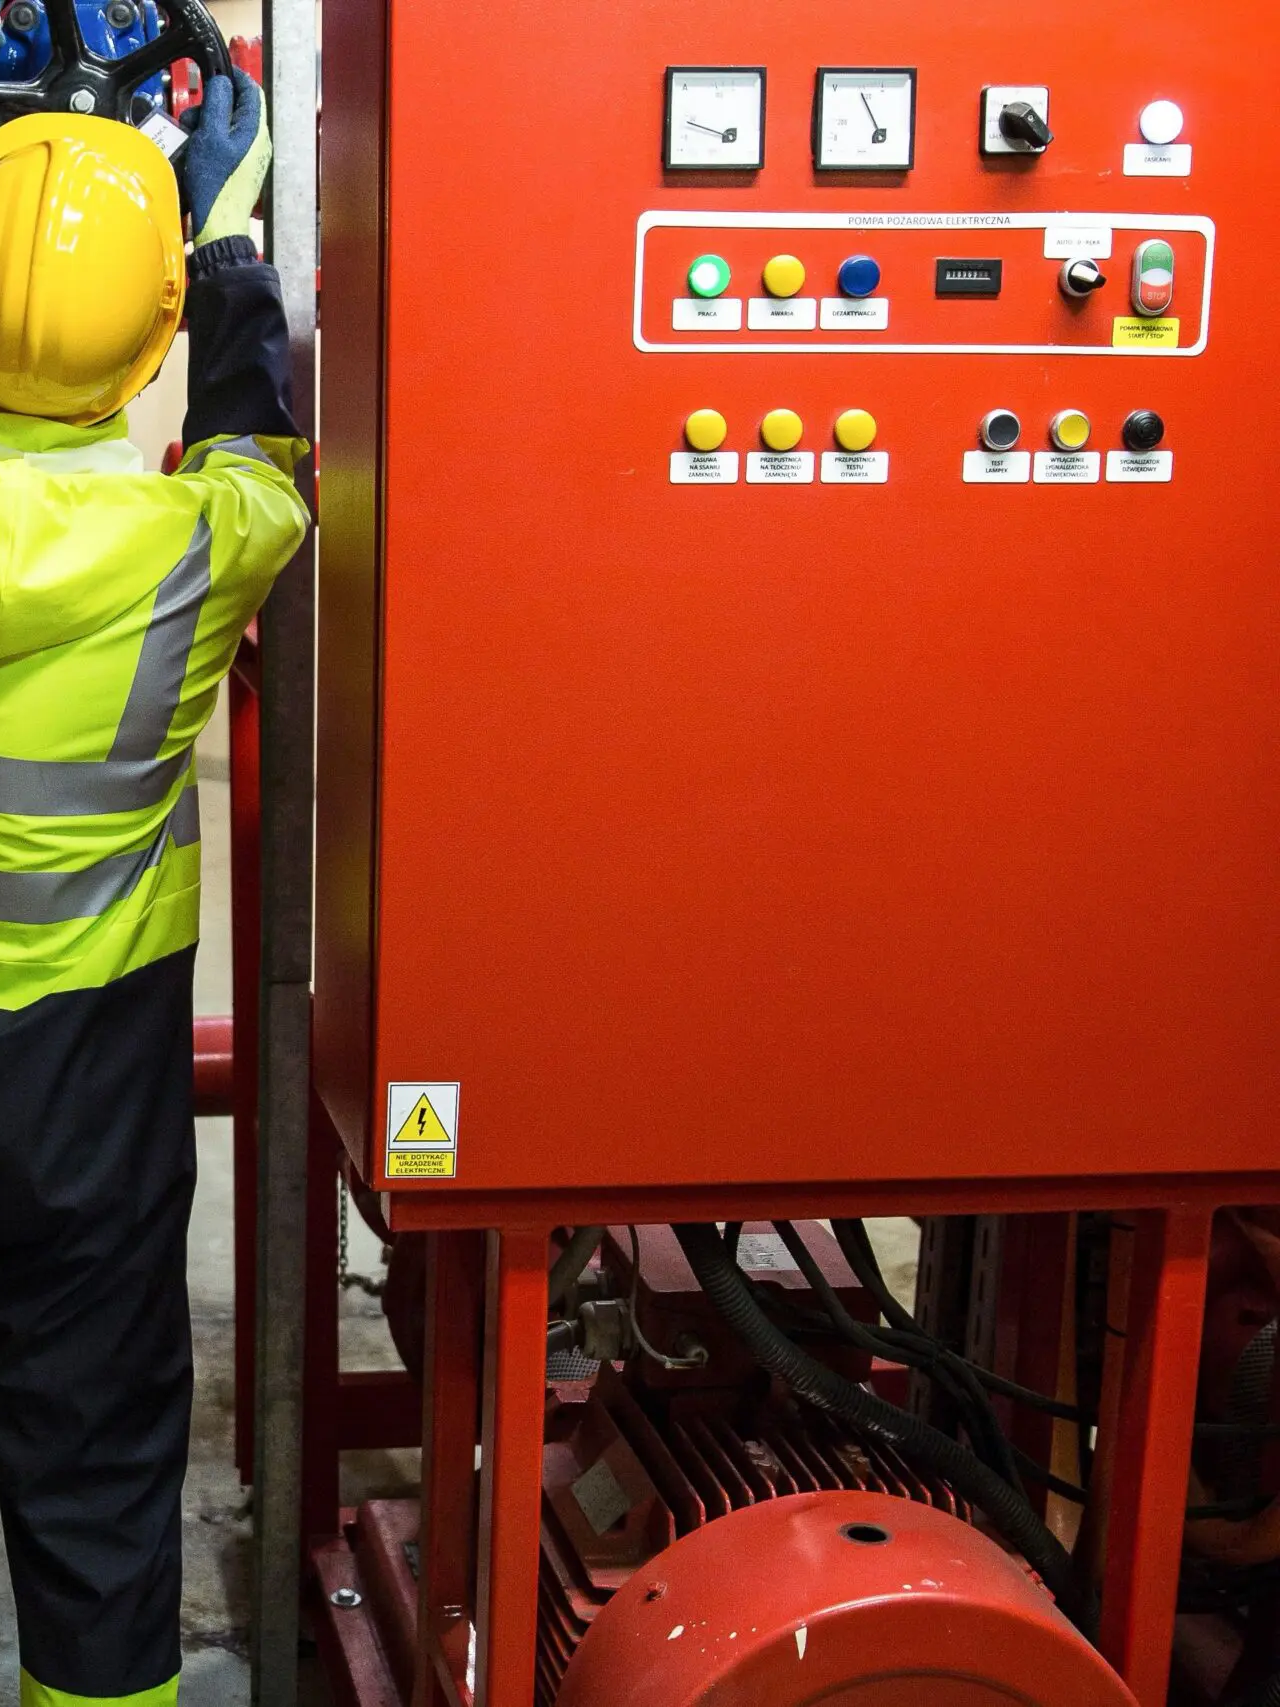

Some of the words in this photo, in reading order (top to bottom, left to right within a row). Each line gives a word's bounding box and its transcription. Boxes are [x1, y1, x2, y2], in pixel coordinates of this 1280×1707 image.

[682, 83, 688, 91] A
[832, 84, 838, 92] V
[848, 217, 884, 226] POMPA
[887, 215, 943, 226] POŻAROWA
[946, 216, 1011, 225] ELEKTRYCZNA
[1147, 291, 1167, 300] STOP
